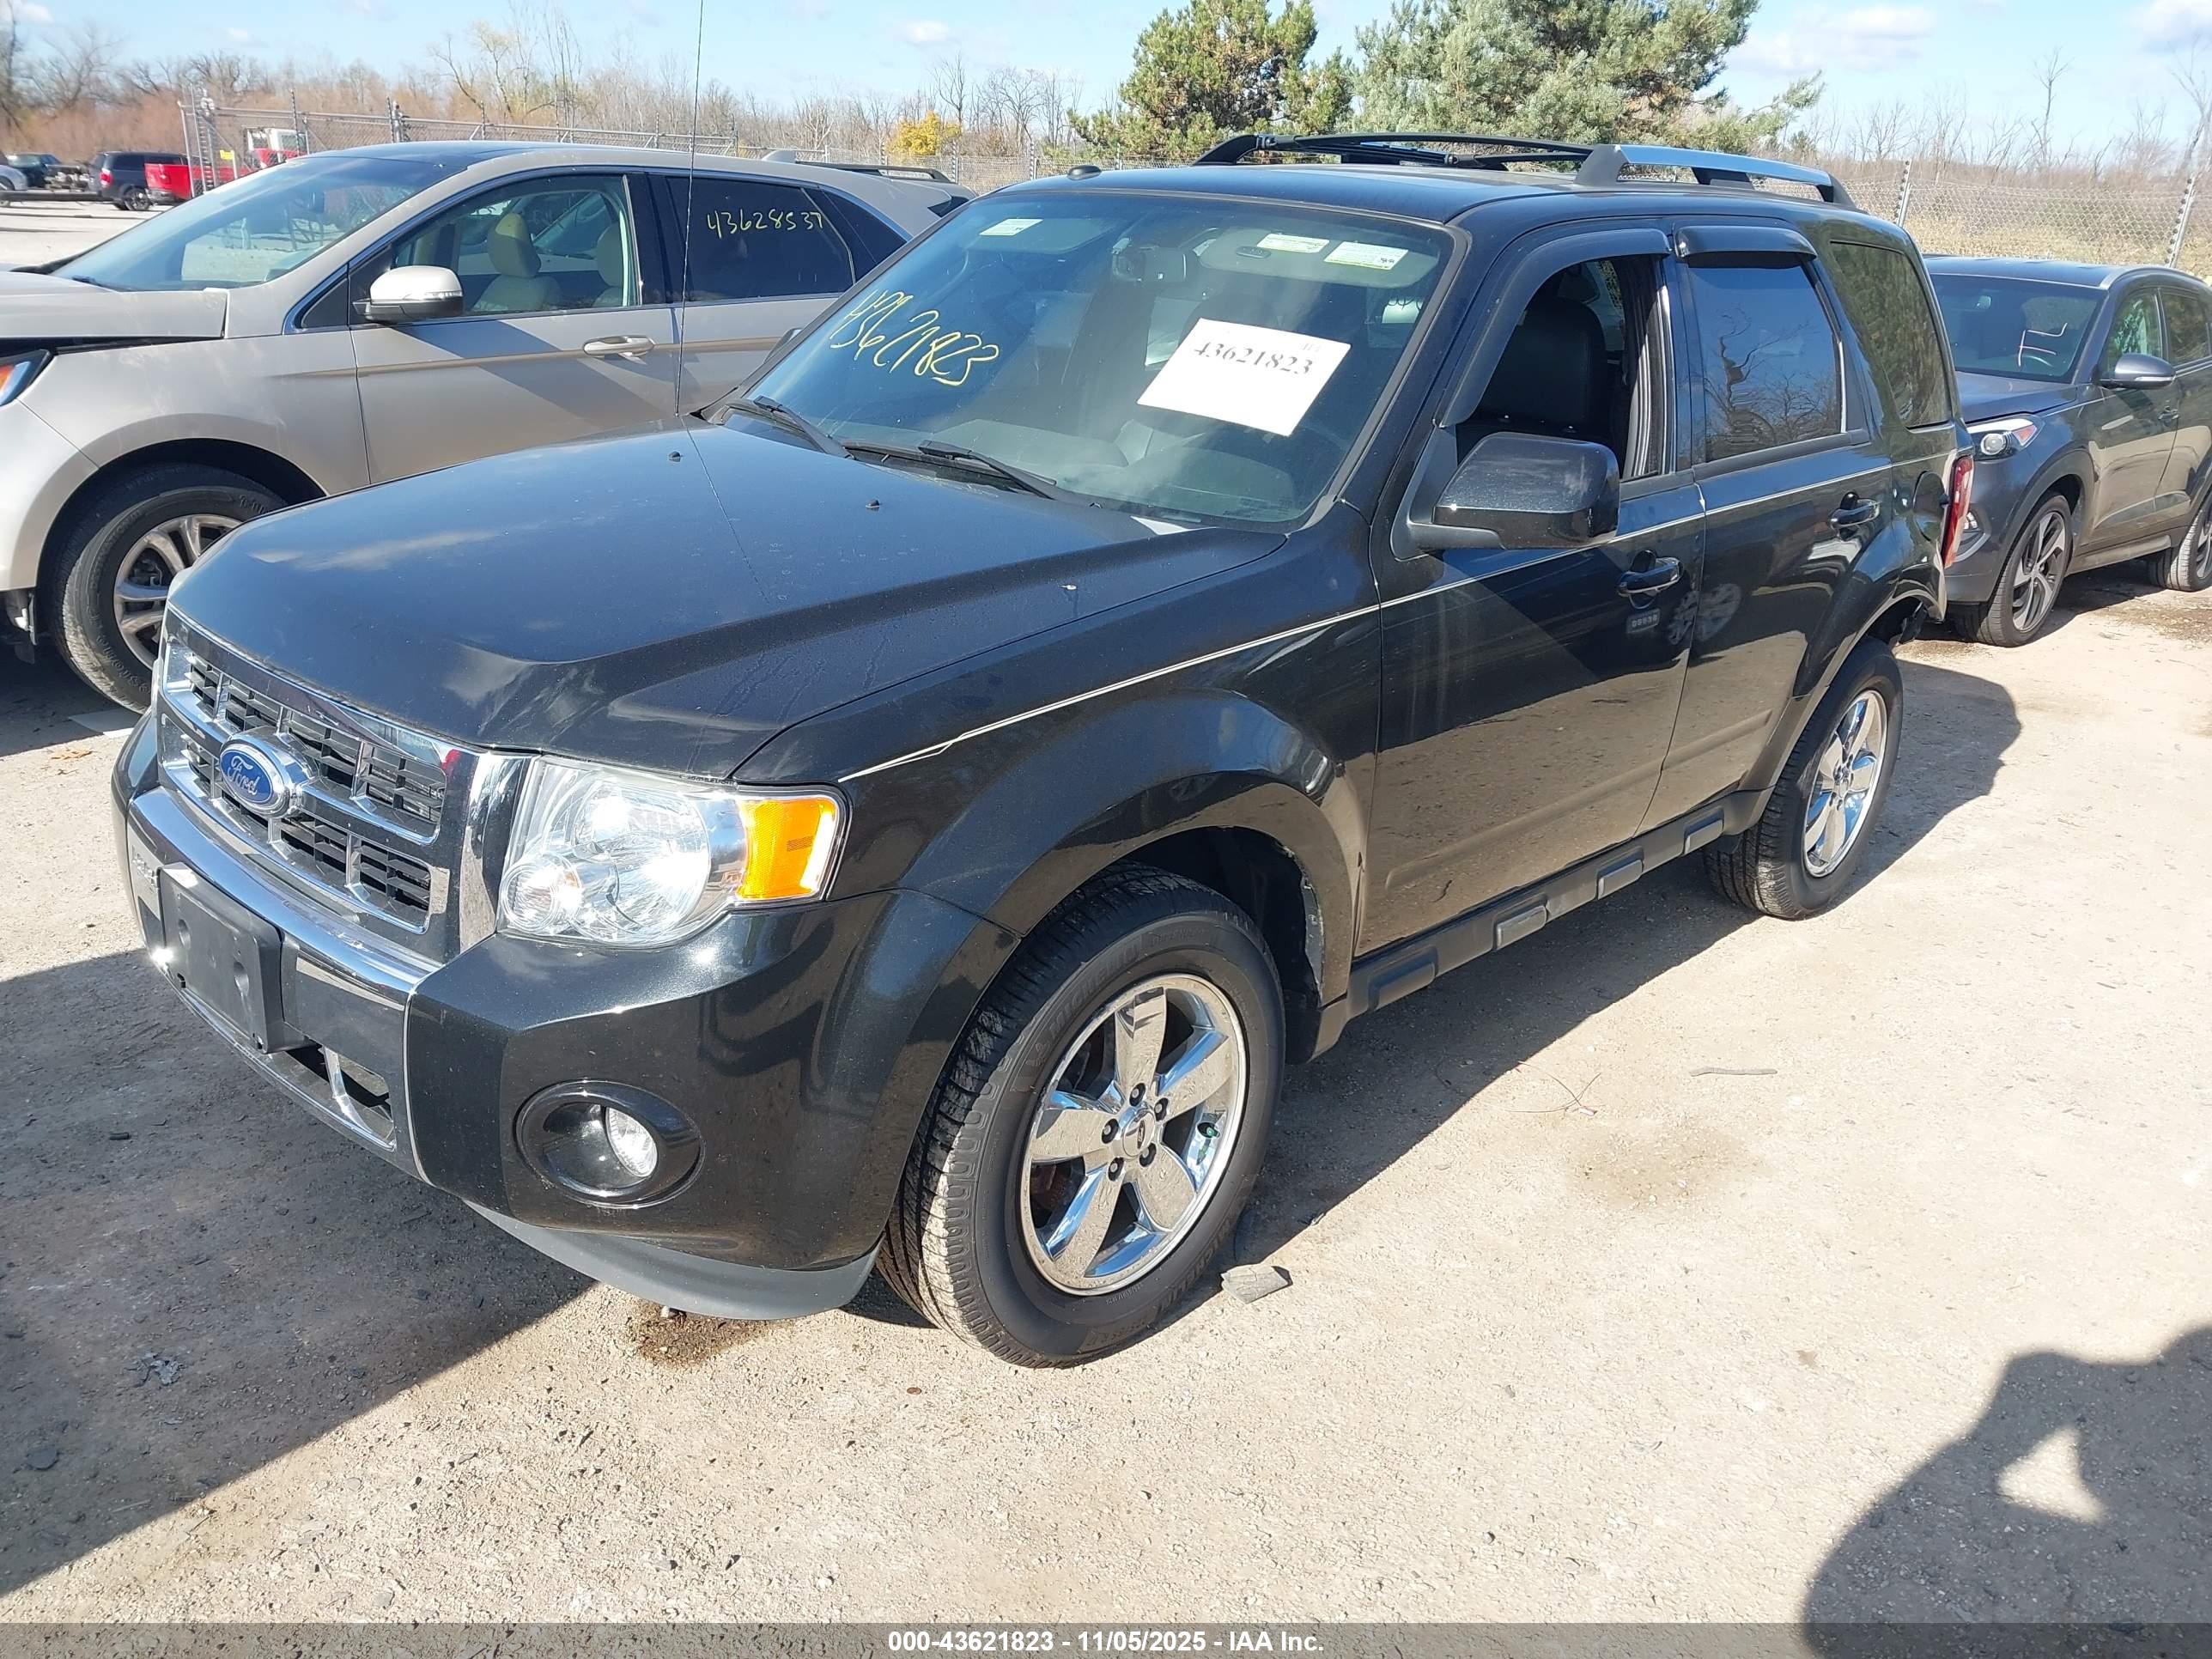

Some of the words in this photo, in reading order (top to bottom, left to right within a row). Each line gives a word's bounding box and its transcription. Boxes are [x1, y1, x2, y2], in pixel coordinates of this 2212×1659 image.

[707, 209, 823, 239] 43628537
[830, 289, 1000, 386] 43621823
[1194, 341, 1313, 375] 43621823
[227, 755, 261, 795] Ford
